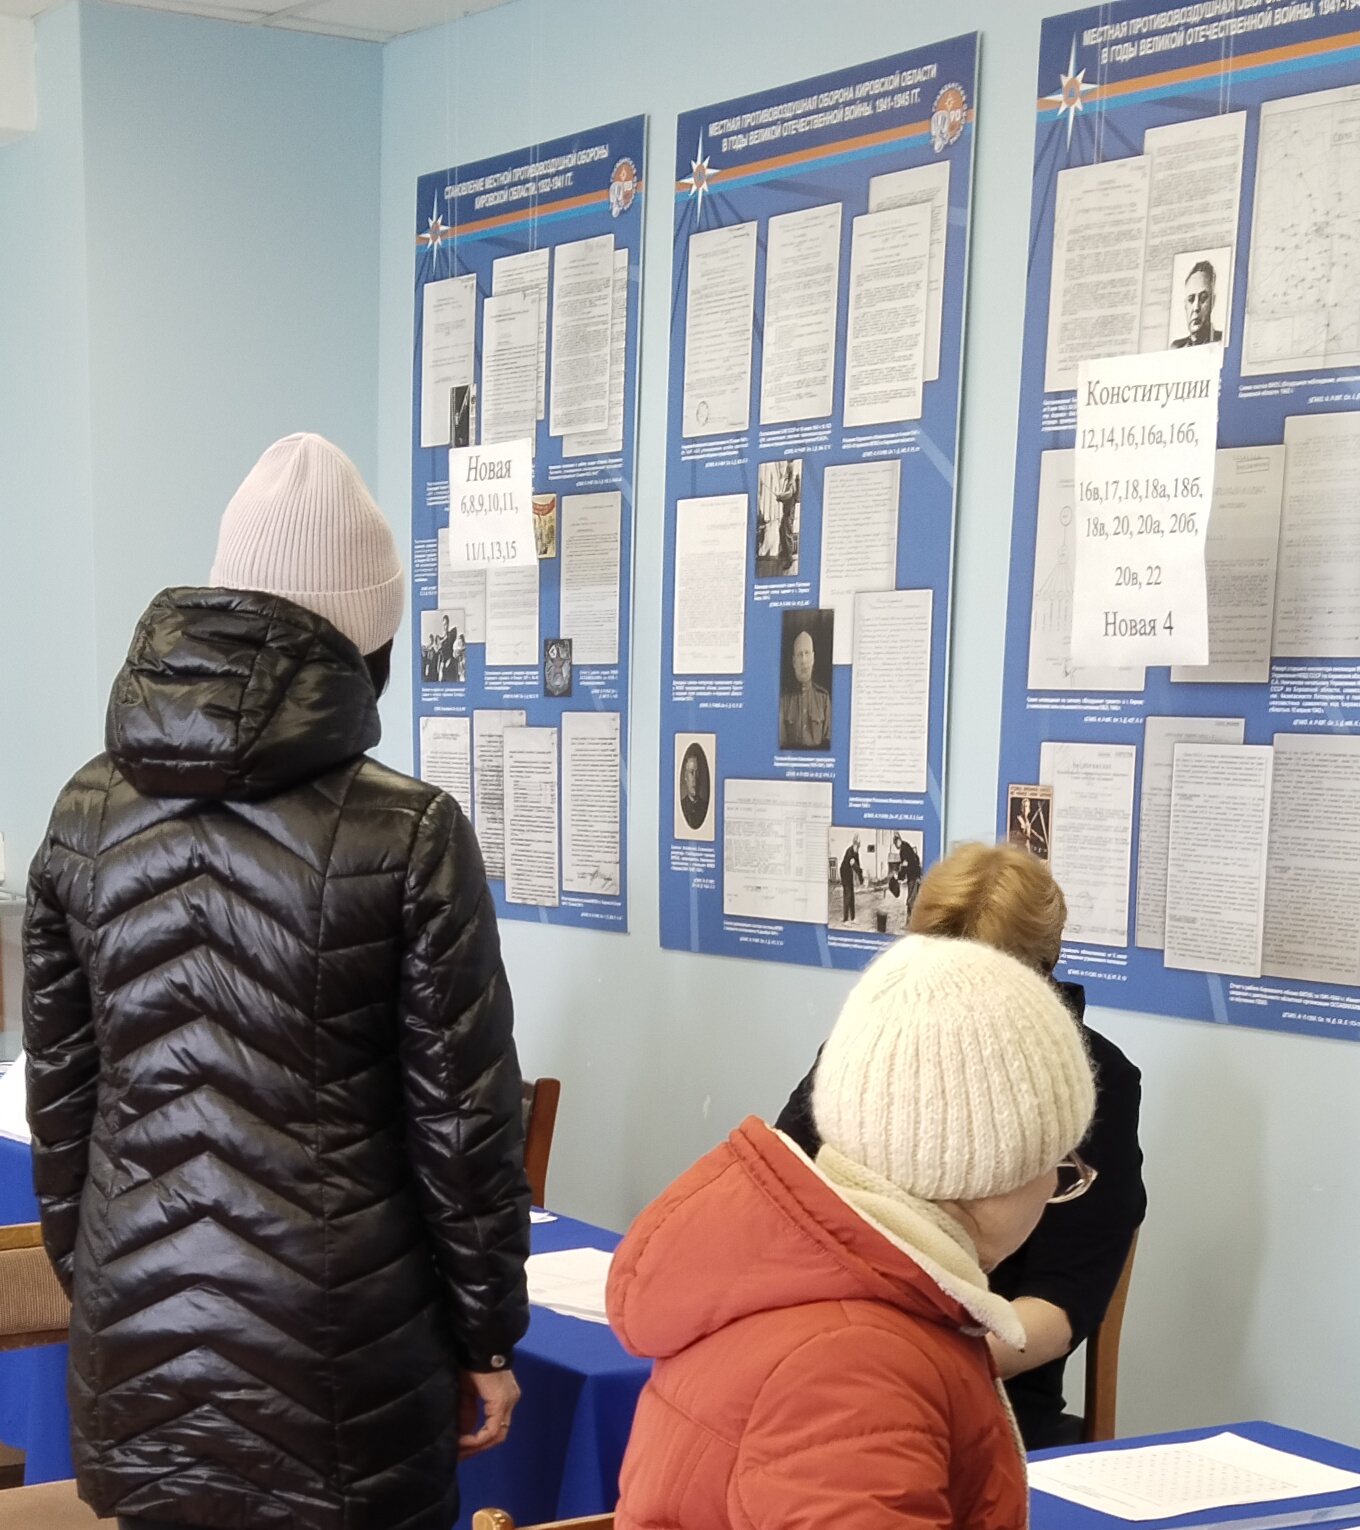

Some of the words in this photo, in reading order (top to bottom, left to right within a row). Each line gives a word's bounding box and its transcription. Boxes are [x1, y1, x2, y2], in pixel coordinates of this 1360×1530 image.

[1082, 21, 1129, 46] МЕСТНАЯ
[1100, 47, 1108, 64] В
[1110, 40, 1138, 62] ГОДЫ
[1139, 26, 1184, 56] ВЕЛИКОЙ
[1186, 7, 1272, 45] ОТЕЧЕСТВЕННОЙ
[818, 85, 854, 108] ОБОРОНА
[854, 70, 900, 98] КИРОВСКОЙ
[901, 63, 937, 86] ОБЛАСТИ
[749, 121, 781, 145] ВЕЛИКОЙ
[1085, 379, 1211, 408] Конституции
[466, 455, 512, 482] Новая
[460, 492, 519, 517] 6,8,9,10,11,
[1113, 515, 1133, 539] 20,
[466, 541, 517, 563] 11/1,13,15
[1146, 565, 1161, 585] 22
[1103, 611, 1157, 637] Новая
[1163, 610, 1174, 636] 4
